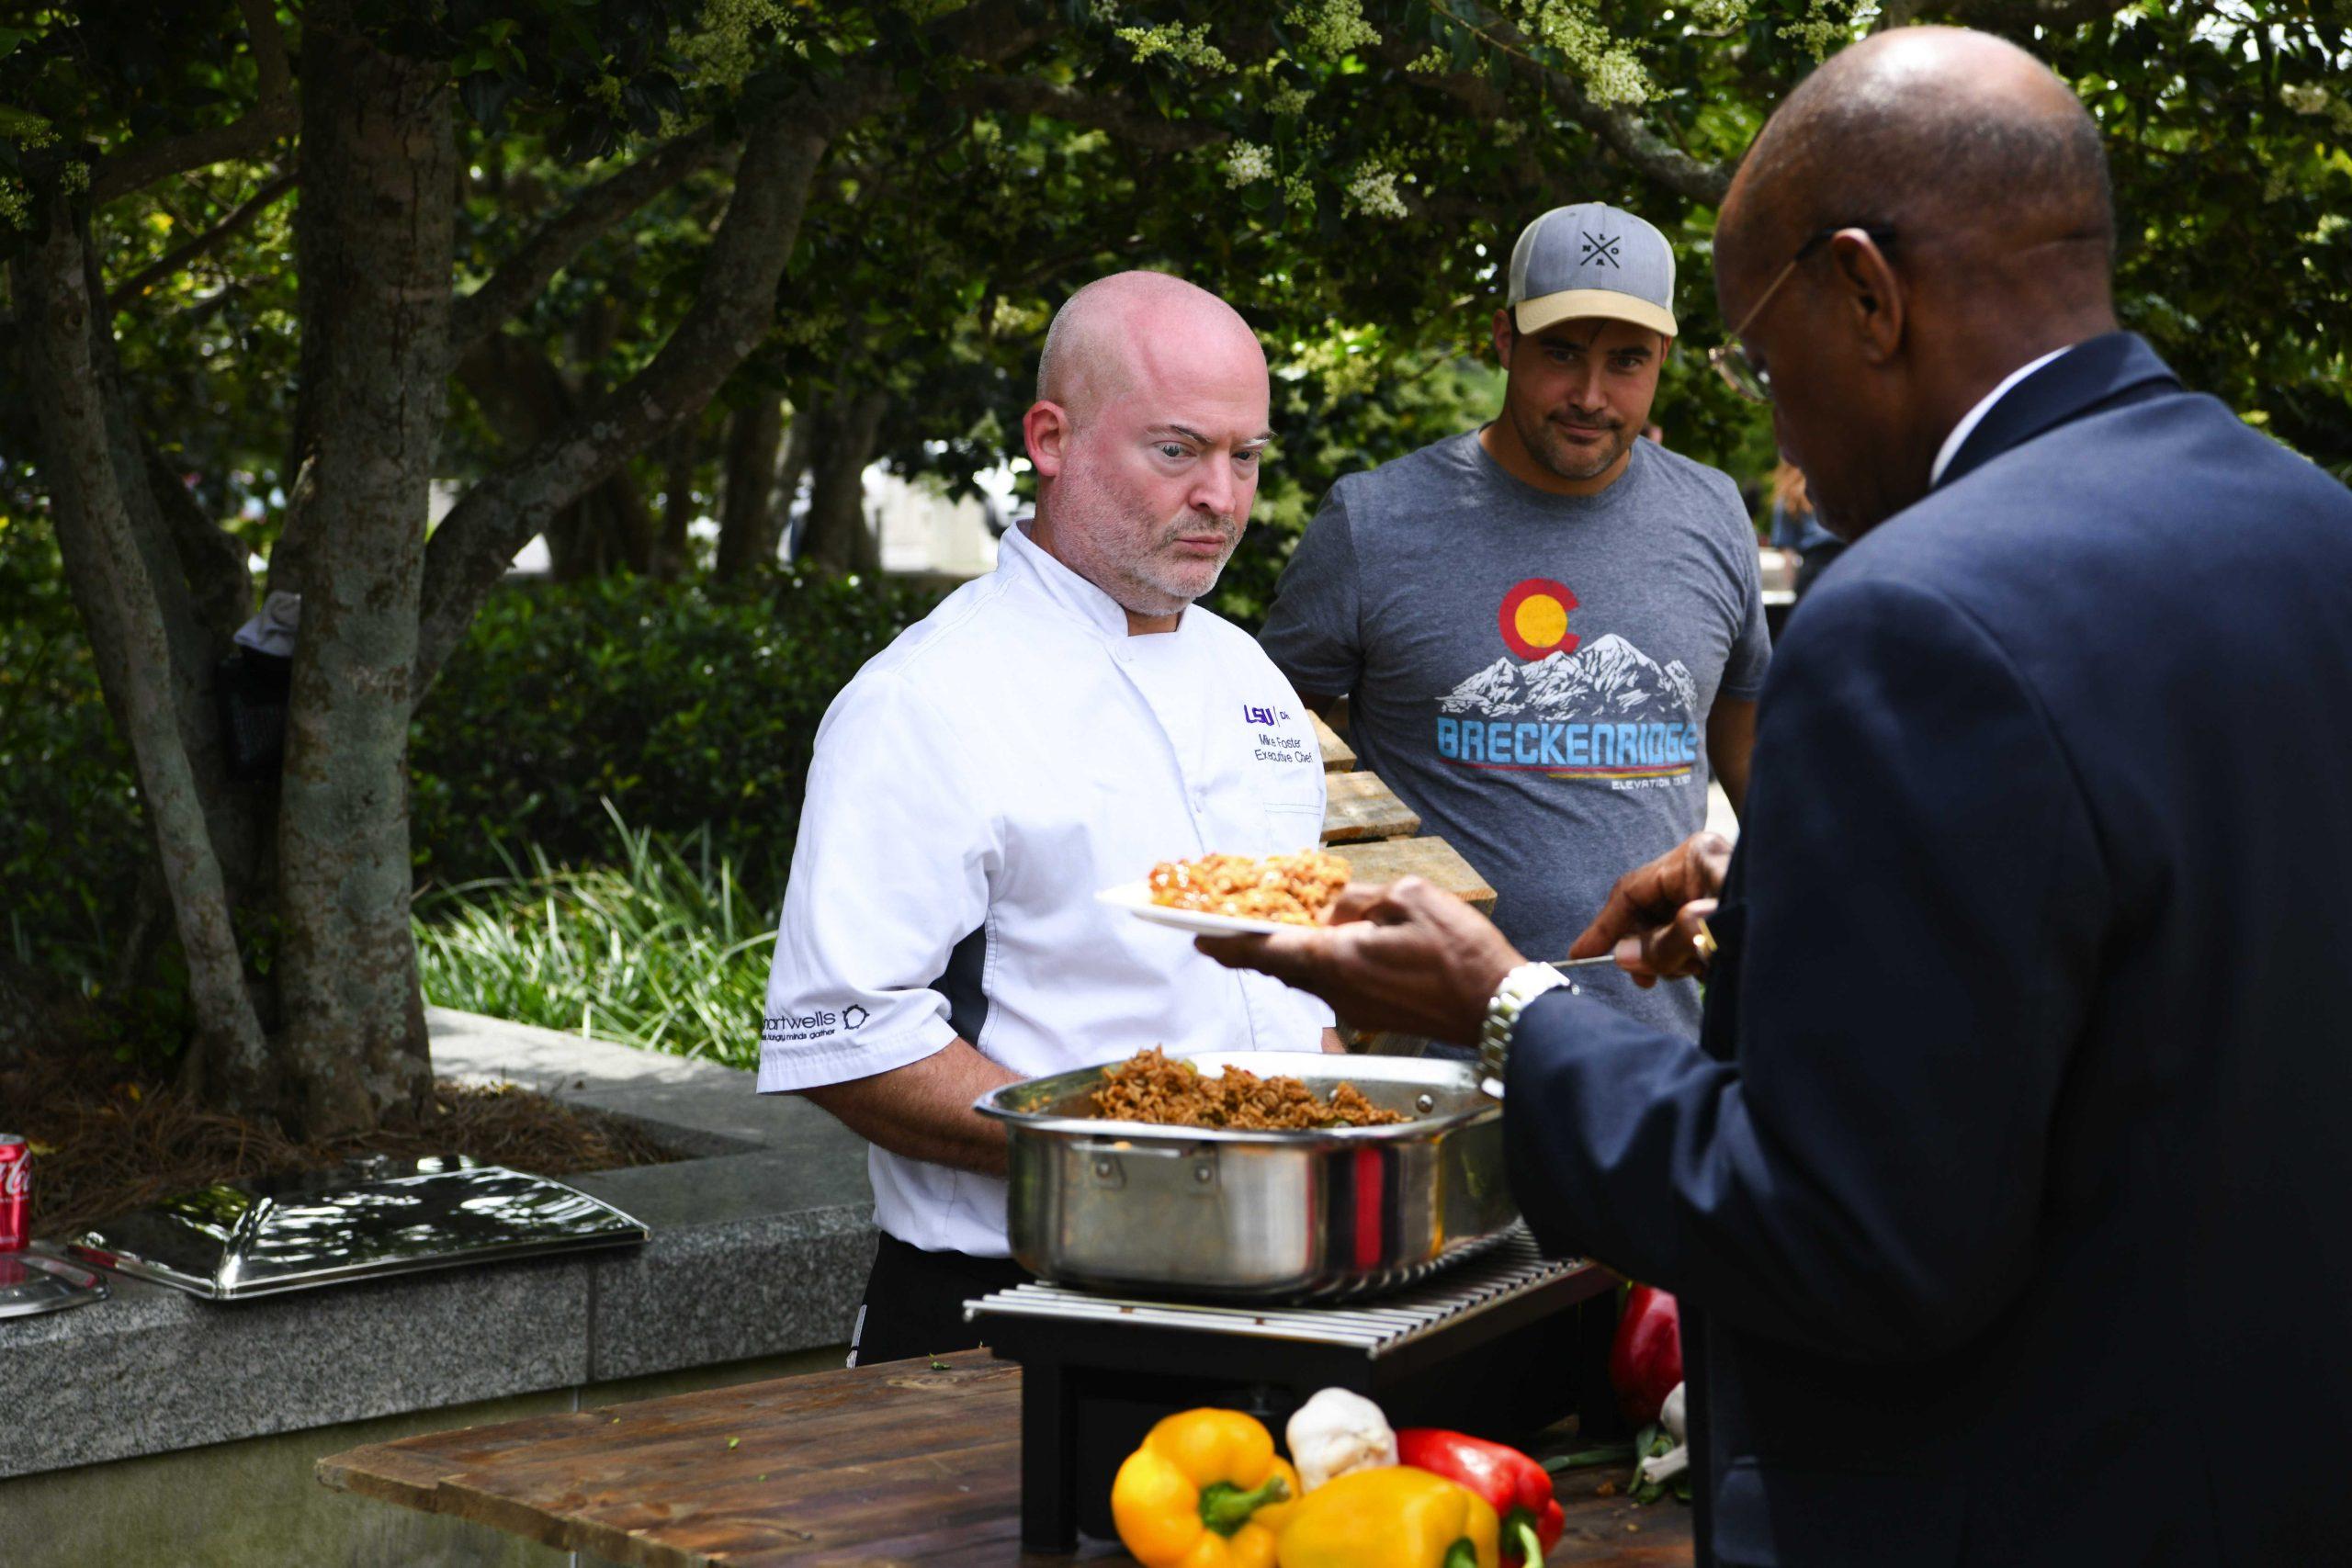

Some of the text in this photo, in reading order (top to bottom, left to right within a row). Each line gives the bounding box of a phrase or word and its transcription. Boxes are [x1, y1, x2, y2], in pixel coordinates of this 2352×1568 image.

[1243, 704, 1275, 727] LSU
[1258, 733, 1302, 750] Mike Foster
[1437, 716, 1698, 765] BRECKENRIDGE
[1254, 749, 1315, 763] Executive Chef
[1611, 777, 1671, 791] ELEVATION
[763, 1010, 836, 1031] hartwells
[786, 1032, 808, 1042] minds
[808, 1028, 836, 1040] gather
